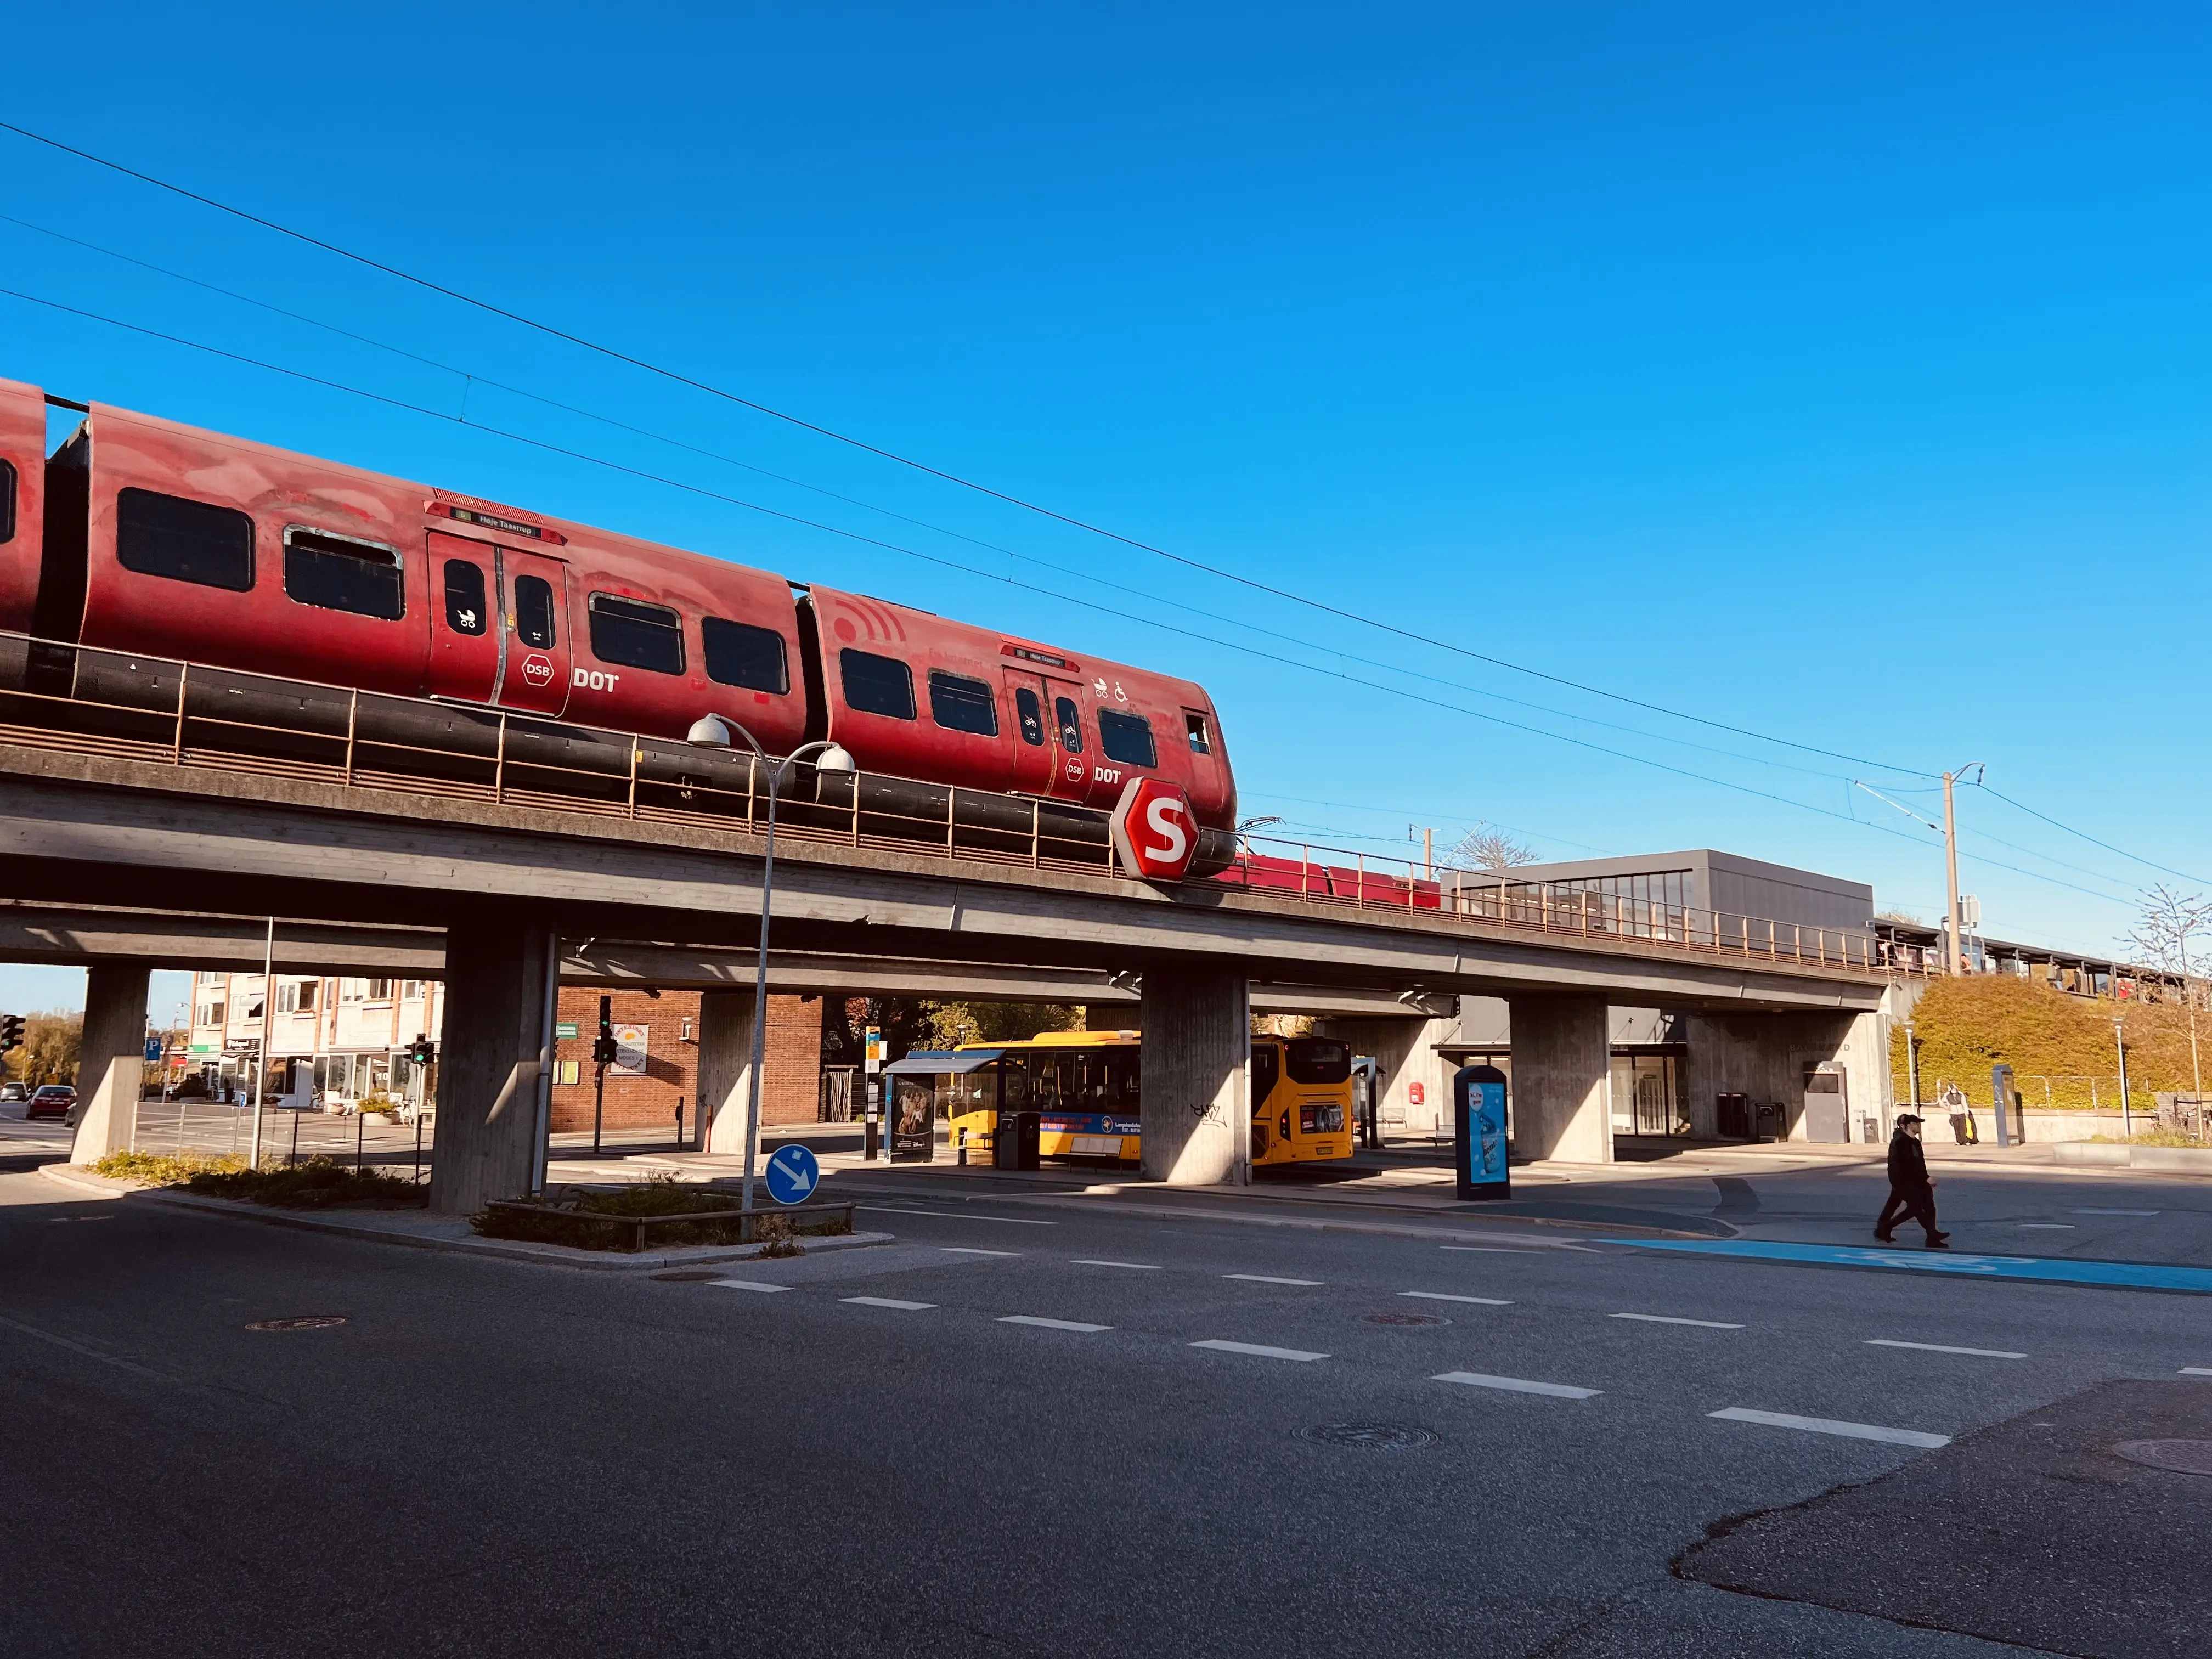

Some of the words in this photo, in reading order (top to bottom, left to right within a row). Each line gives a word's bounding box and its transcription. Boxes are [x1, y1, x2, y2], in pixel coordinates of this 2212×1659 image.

[500, 521, 532, 534] Taastrup
[526, 664, 550, 676] DSB
[573, 668, 619, 692] DOT
[1068, 765, 1082, 775] DSB
[1095, 766, 1121, 784] DOT
[1145, 797, 1186, 862] S
[615, 1024, 645, 1037] OSTEHUSET
[149, 1040, 159, 1051] P
[376, 1072, 389, 1081] 10
